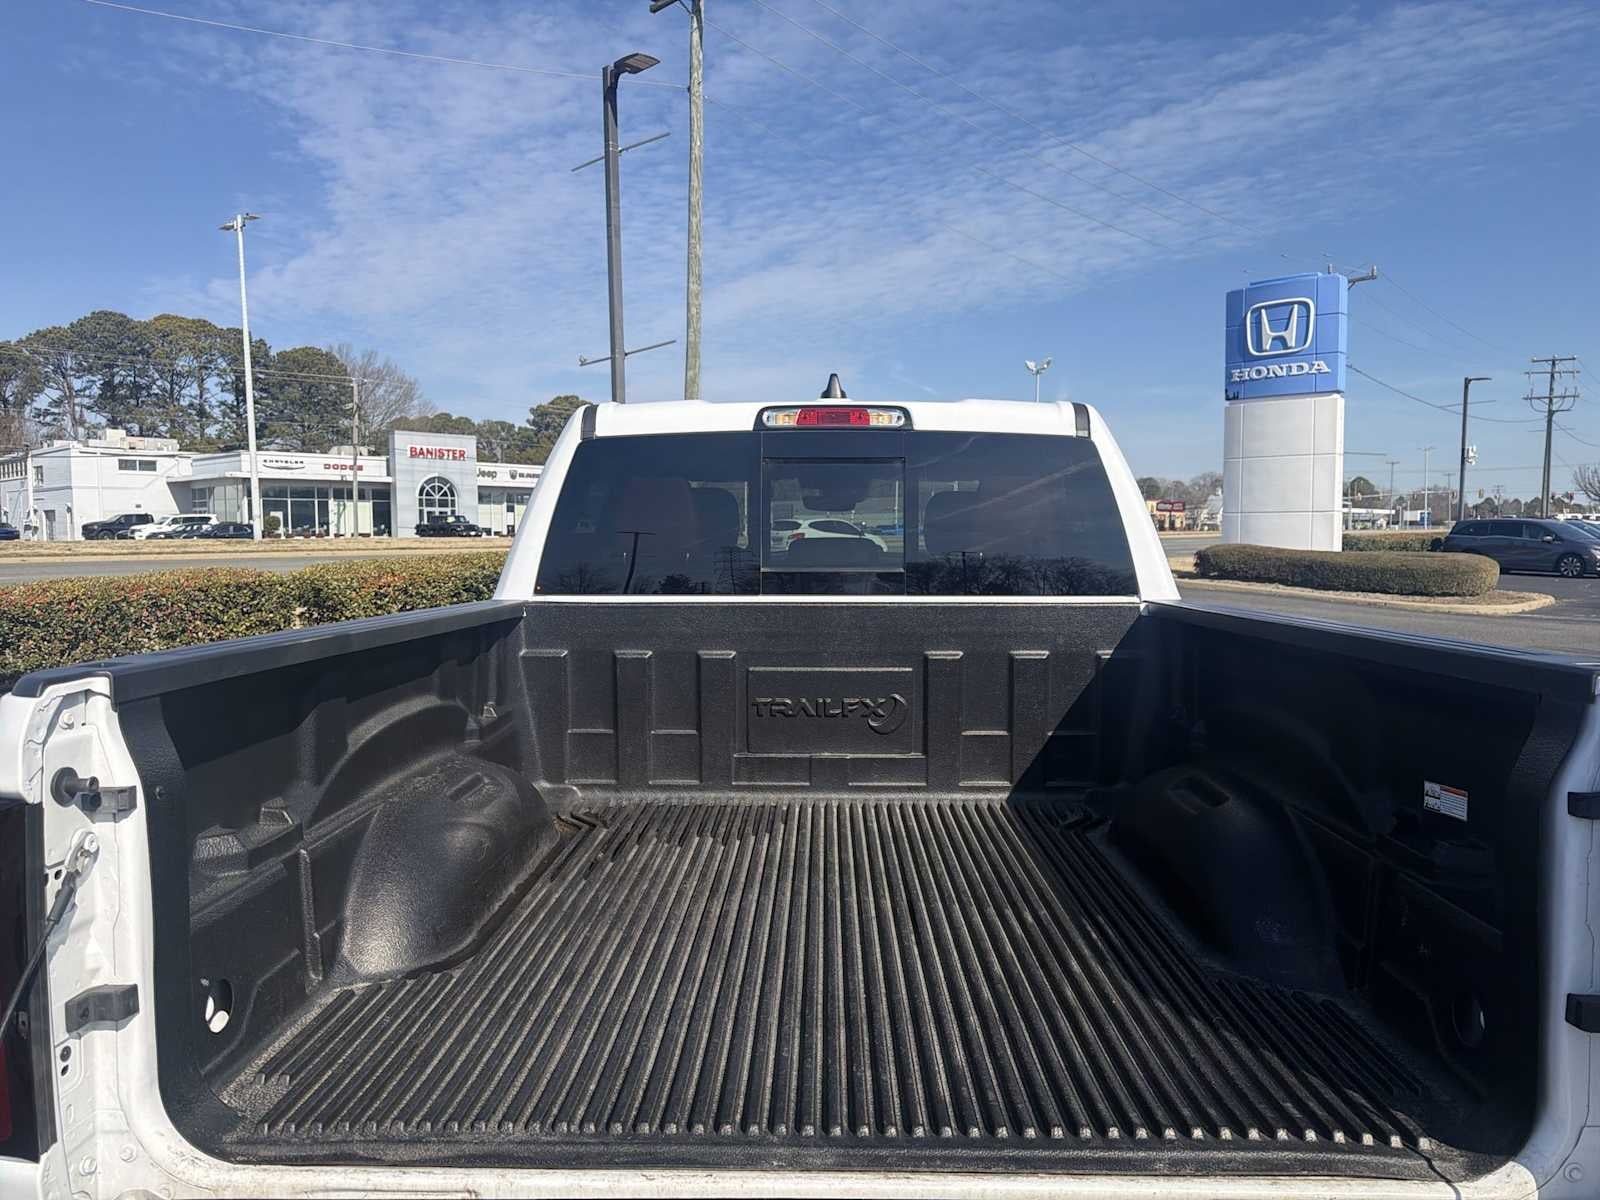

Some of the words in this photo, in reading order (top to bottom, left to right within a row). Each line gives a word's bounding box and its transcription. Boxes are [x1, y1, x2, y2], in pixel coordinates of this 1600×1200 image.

[1231, 361, 1331, 382] HONDA
[409, 446, 467, 461] BANISTER
[323, 463, 363, 471] DODGE
[476, 468, 498, 480] Jeep
[752, 697, 886, 719] TRAILFX
